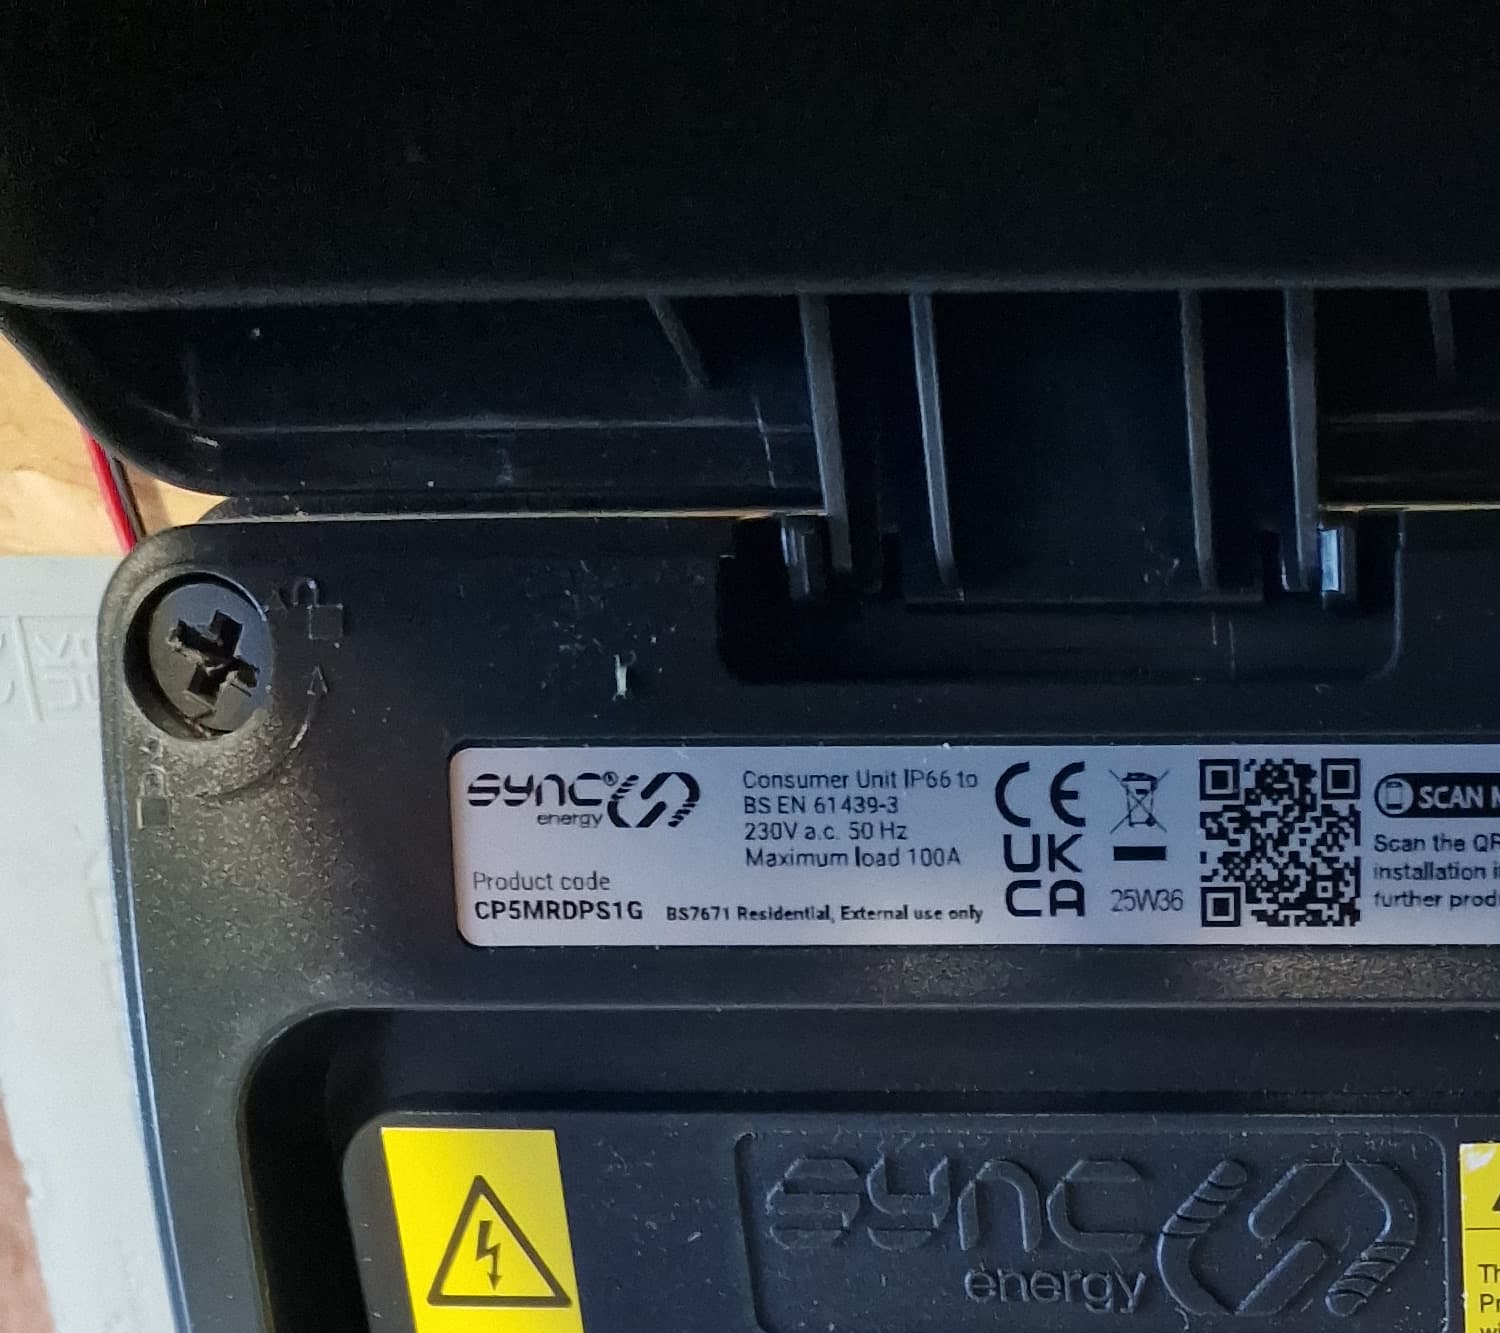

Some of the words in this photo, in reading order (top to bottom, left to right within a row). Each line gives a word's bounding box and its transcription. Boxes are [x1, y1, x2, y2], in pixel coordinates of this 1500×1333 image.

[743, 771, 849, 789] Consumer
[857, 770, 897, 789] Unit
[903, 771, 952, 789] IP66
[744, 797, 773, 815] BS
[777, 797, 806, 814] EN
[814, 796, 899, 814] 61439-3
[1419, 787, 1484, 807] SCAN
[537, 812, 604, 829] energy
[744, 823, 797, 841] 230V
[804, 825, 840, 841] a.c.
[849, 823, 874, 840] 50
[880, 822, 907, 840] Hz
[1374, 833, 1425, 852] Scan
[1433, 833, 1466, 852] the
[746, 849, 848, 868] Maximum
[855, 848, 899, 867] load
[908, 848, 960, 866] 100A
[1004, 834, 1082, 873] UK
[1374, 861, 1485, 880] installation
[474, 871, 552, 891] Product
[560, 871, 611, 891] code
[1110, 890, 1183, 912] 25W36
[1374, 890, 1442, 908] further
[474, 901, 643, 921] CP5MRDPS1G
[667, 907, 731, 922] BS7671
[737, 906, 835, 924] Residential,
[841, 906, 908, 922] External
[913, 910, 942, 922] use
[949, 906, 983, 925] only
[964, 1267, 1146, 1314] energy
